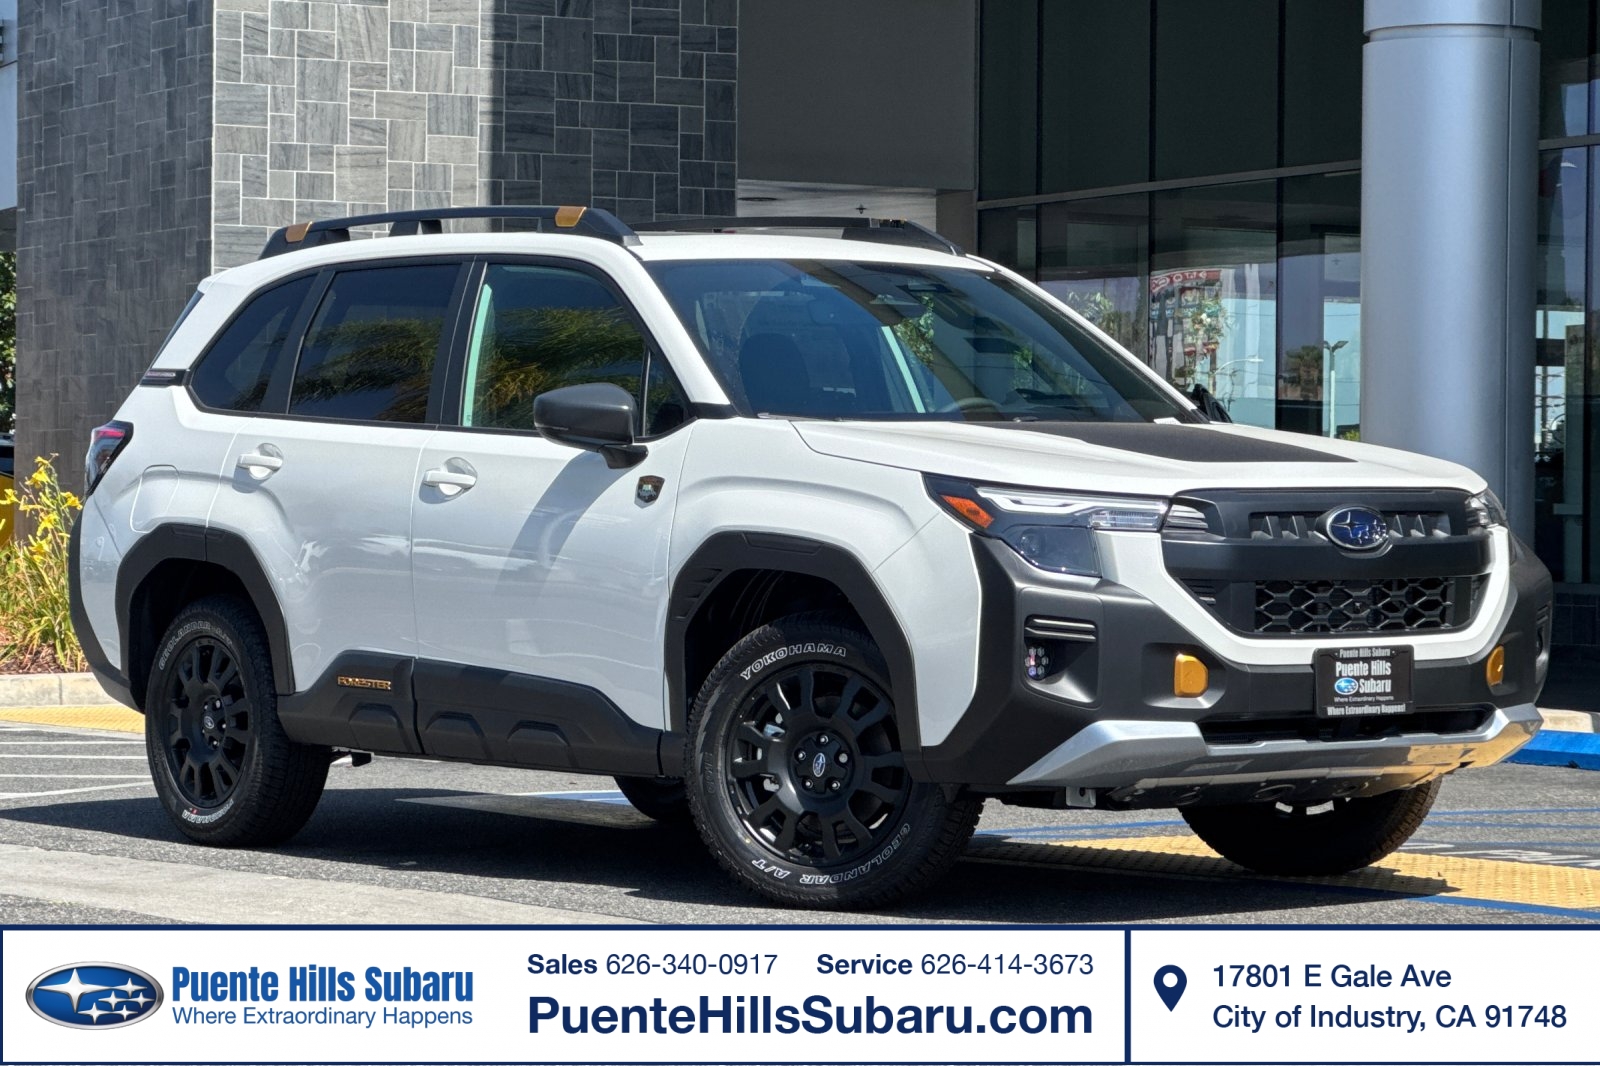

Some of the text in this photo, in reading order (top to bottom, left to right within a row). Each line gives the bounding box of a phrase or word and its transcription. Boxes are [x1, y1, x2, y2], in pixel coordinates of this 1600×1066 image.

[1339, 647, 1391, 658] Puente Hills Subaru
[740, 642, 847, 681] YOKOHAMA
[1335, 659, 1391, 677] Puente Hills
[337, 676, 392, 691] FORESTER
[1359, 678, 1392, 693] Subaru
[1327, 703, 1406, 716] Where Extraordinary Happens!
[751, 822, 912, 885] GEOLANDAR A/T
